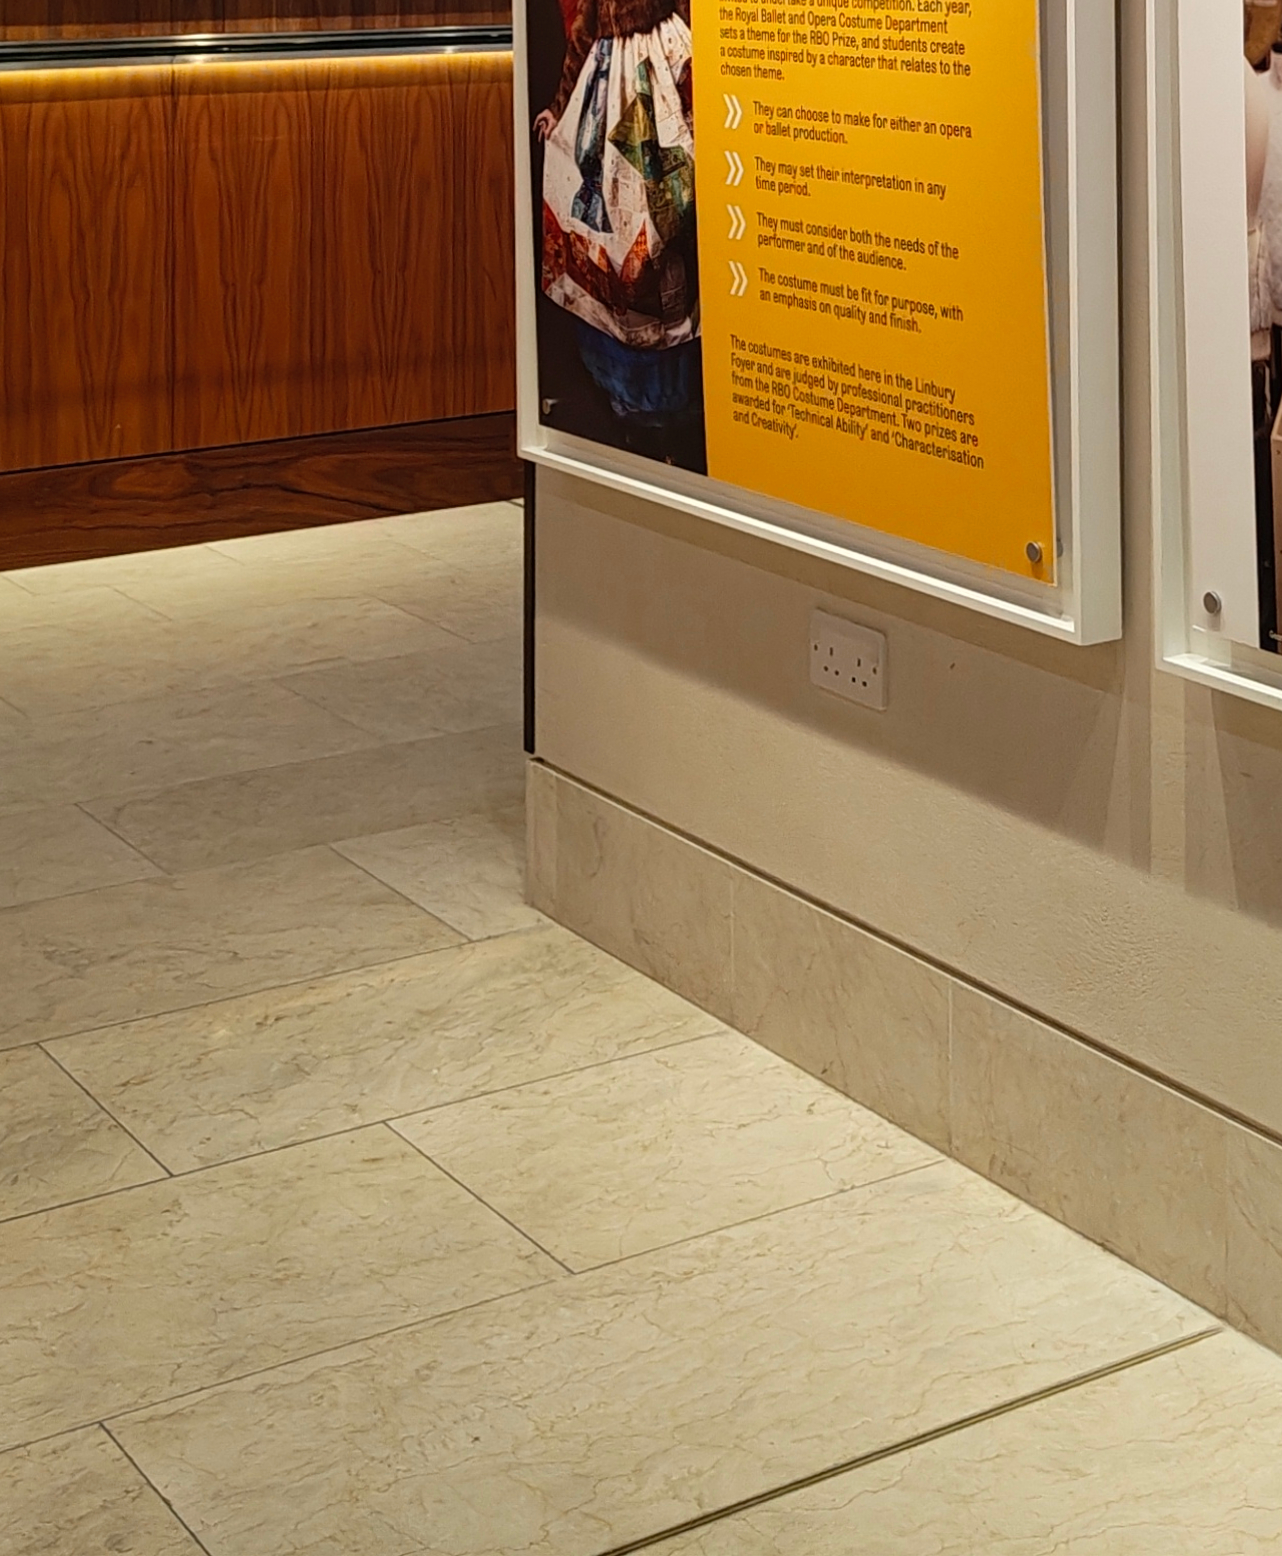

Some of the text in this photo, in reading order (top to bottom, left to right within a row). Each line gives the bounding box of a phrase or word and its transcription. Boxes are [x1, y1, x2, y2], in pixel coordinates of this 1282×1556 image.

[719, 6, 947, 34] the Royal Ballet and Opera Costume Department
[944, 1, 971, 17] year,
[720, 26, 965, 55] sets a theme for the RBO Prize, and students create
[720, 45, 970, 76] a costume inspired by a character that relates to the
[720, 62, 784, 80] chosen theme.
